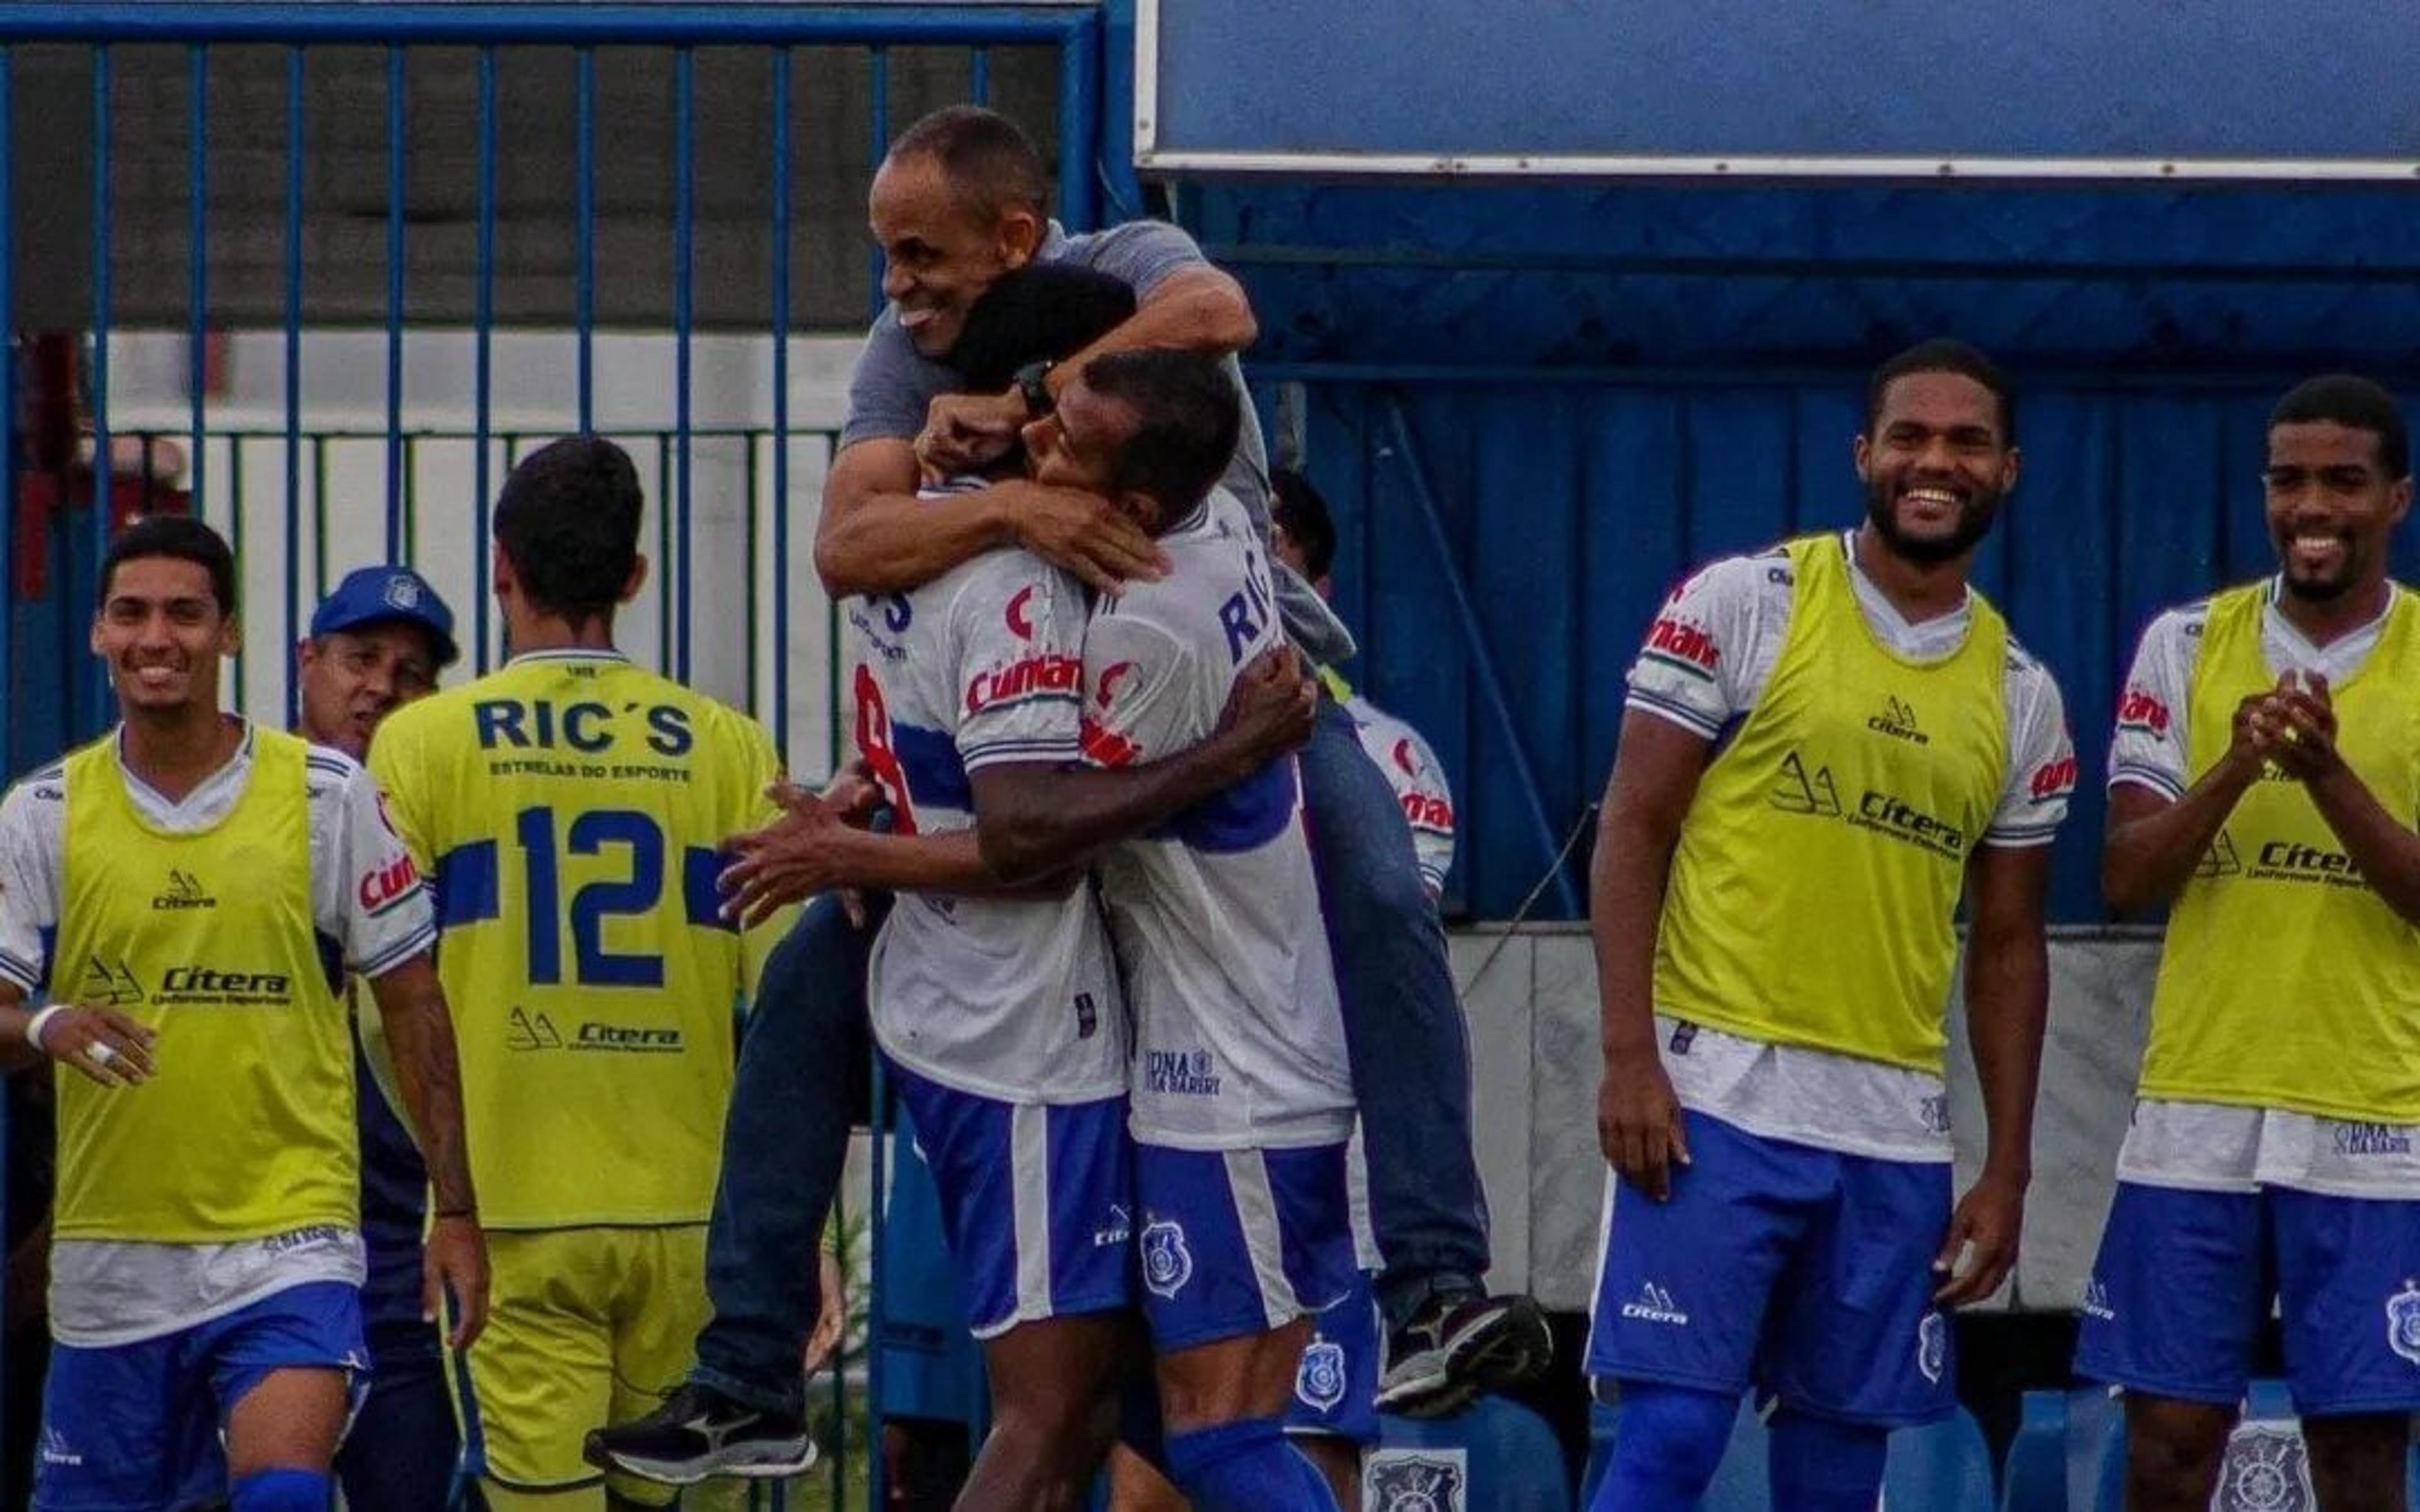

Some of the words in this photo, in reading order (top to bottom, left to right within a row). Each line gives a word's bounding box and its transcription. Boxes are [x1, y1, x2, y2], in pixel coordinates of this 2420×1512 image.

[490, 760, 576, 776] ESTRELAS
[582, 764, 607, 779] DO
[612, 765, 691, 782] ESPORTE
[516, 806, 665, 988] 12
